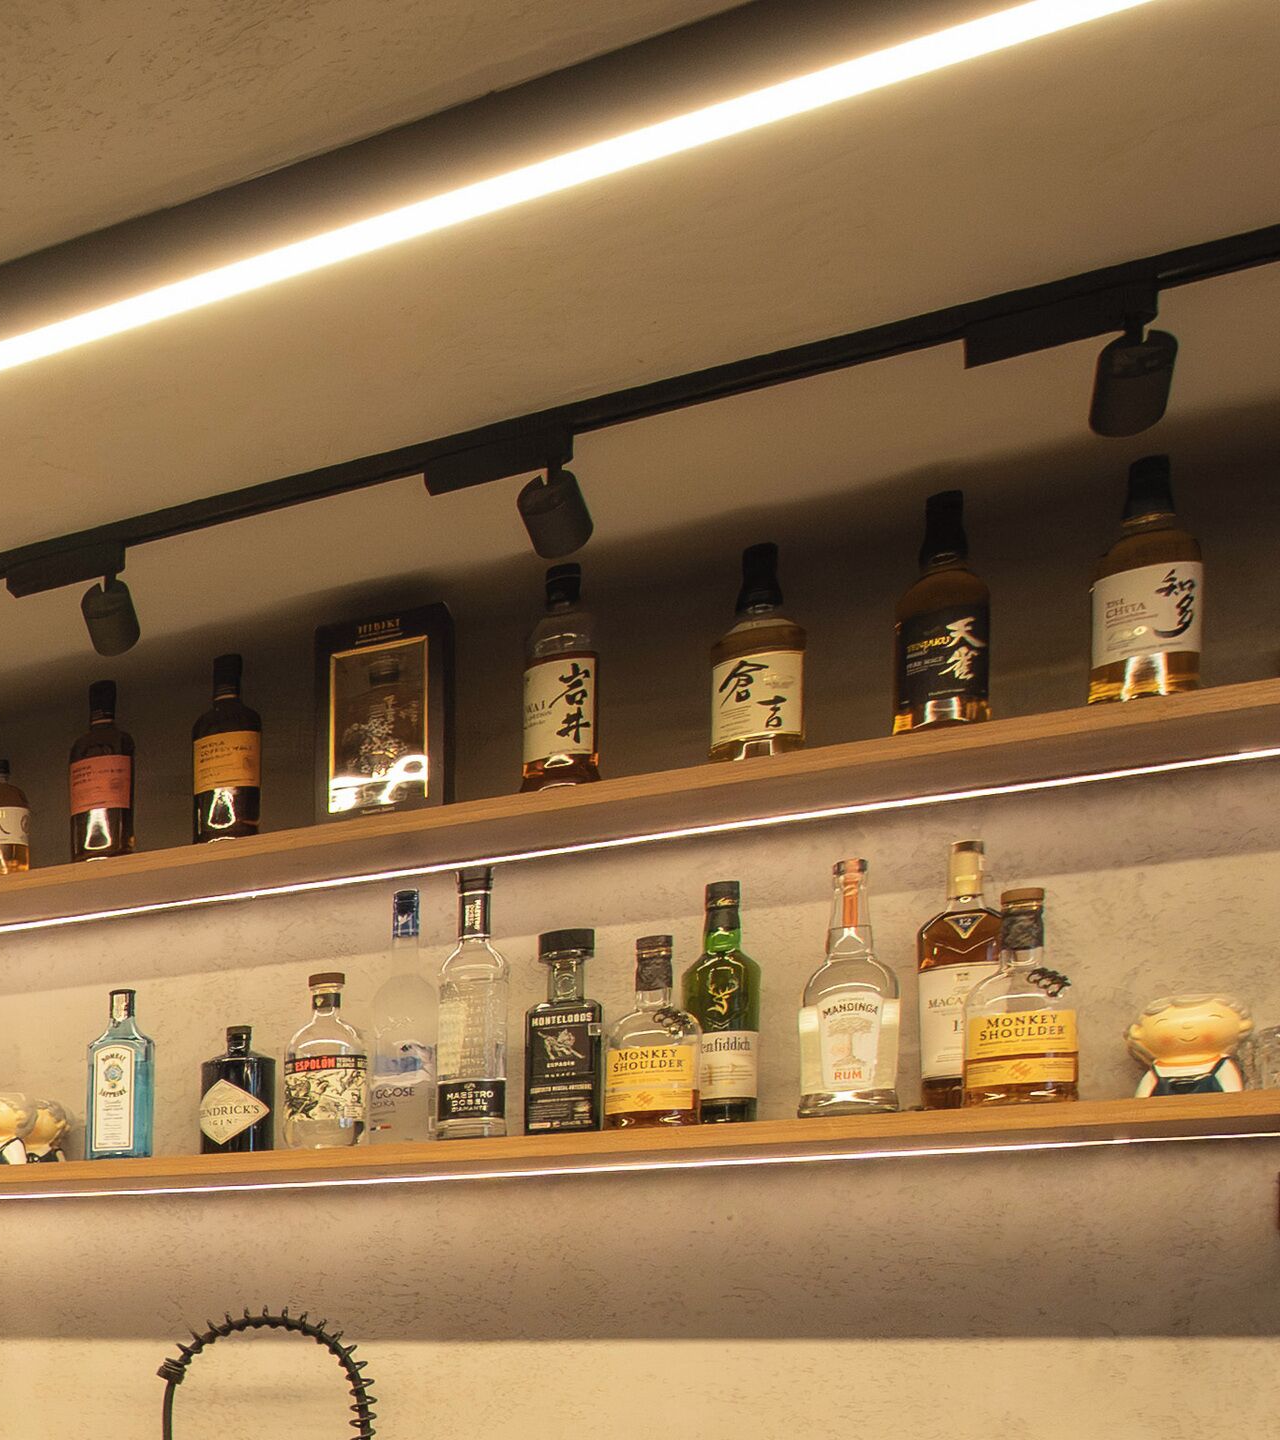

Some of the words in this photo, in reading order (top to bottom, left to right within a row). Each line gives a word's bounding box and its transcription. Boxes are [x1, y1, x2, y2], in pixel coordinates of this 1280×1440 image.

[1152, 568, 1195, 639] 知多
[1106, 603, 1147, 619] CHITA
[822, 1002, 879, 1019] MANDINGA
[986, 1014, 1058, 1029] MONKEY
[979, 1025, 1066, 1041] SHOULDER
[618, 1049, 678, 1063] MONKEY
[613, 1059, 684, 1073] SHOULDER
[834, 1070, 862, 1081] RUM
[375, 1087, 415, 1100] GOOSE
[446, 1090, 495, 1101] MAESTRO
[200, 1104, 260, 1118] ENDRICK'S
